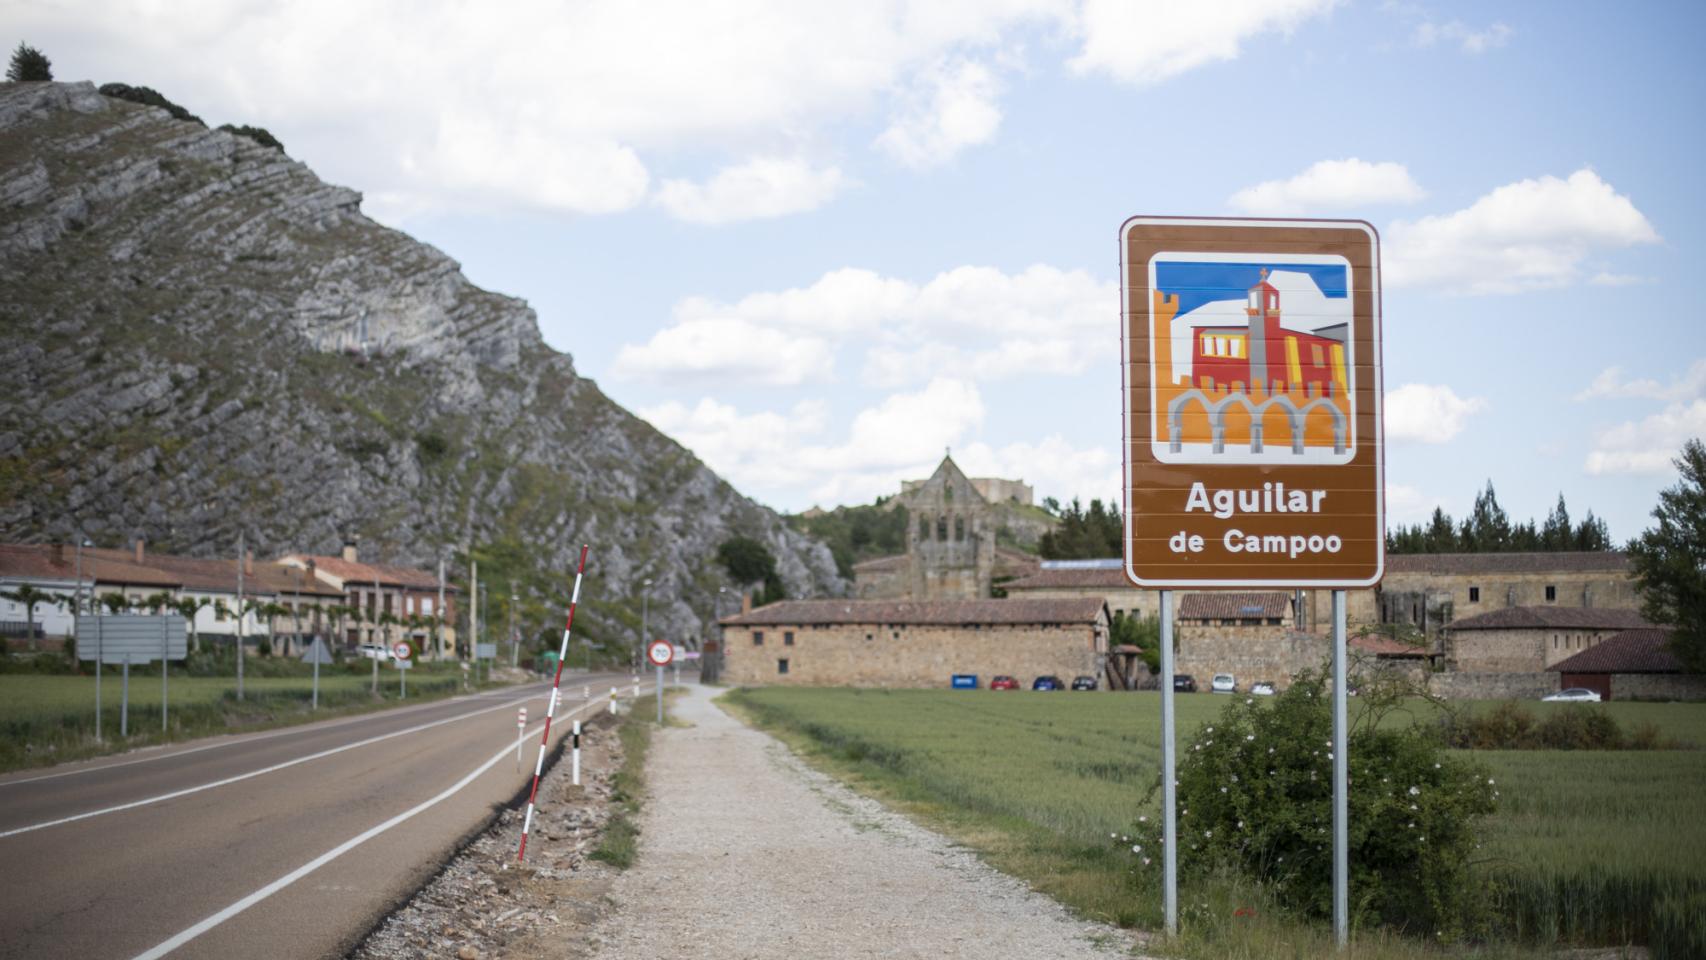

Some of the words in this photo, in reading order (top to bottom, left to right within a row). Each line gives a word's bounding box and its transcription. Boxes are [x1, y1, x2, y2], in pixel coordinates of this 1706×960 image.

[1185, 481, 1326, 519] Aguilar
[1169, 530, 1204, 553] de
[1223, 528, 1342, 559] Campoo
